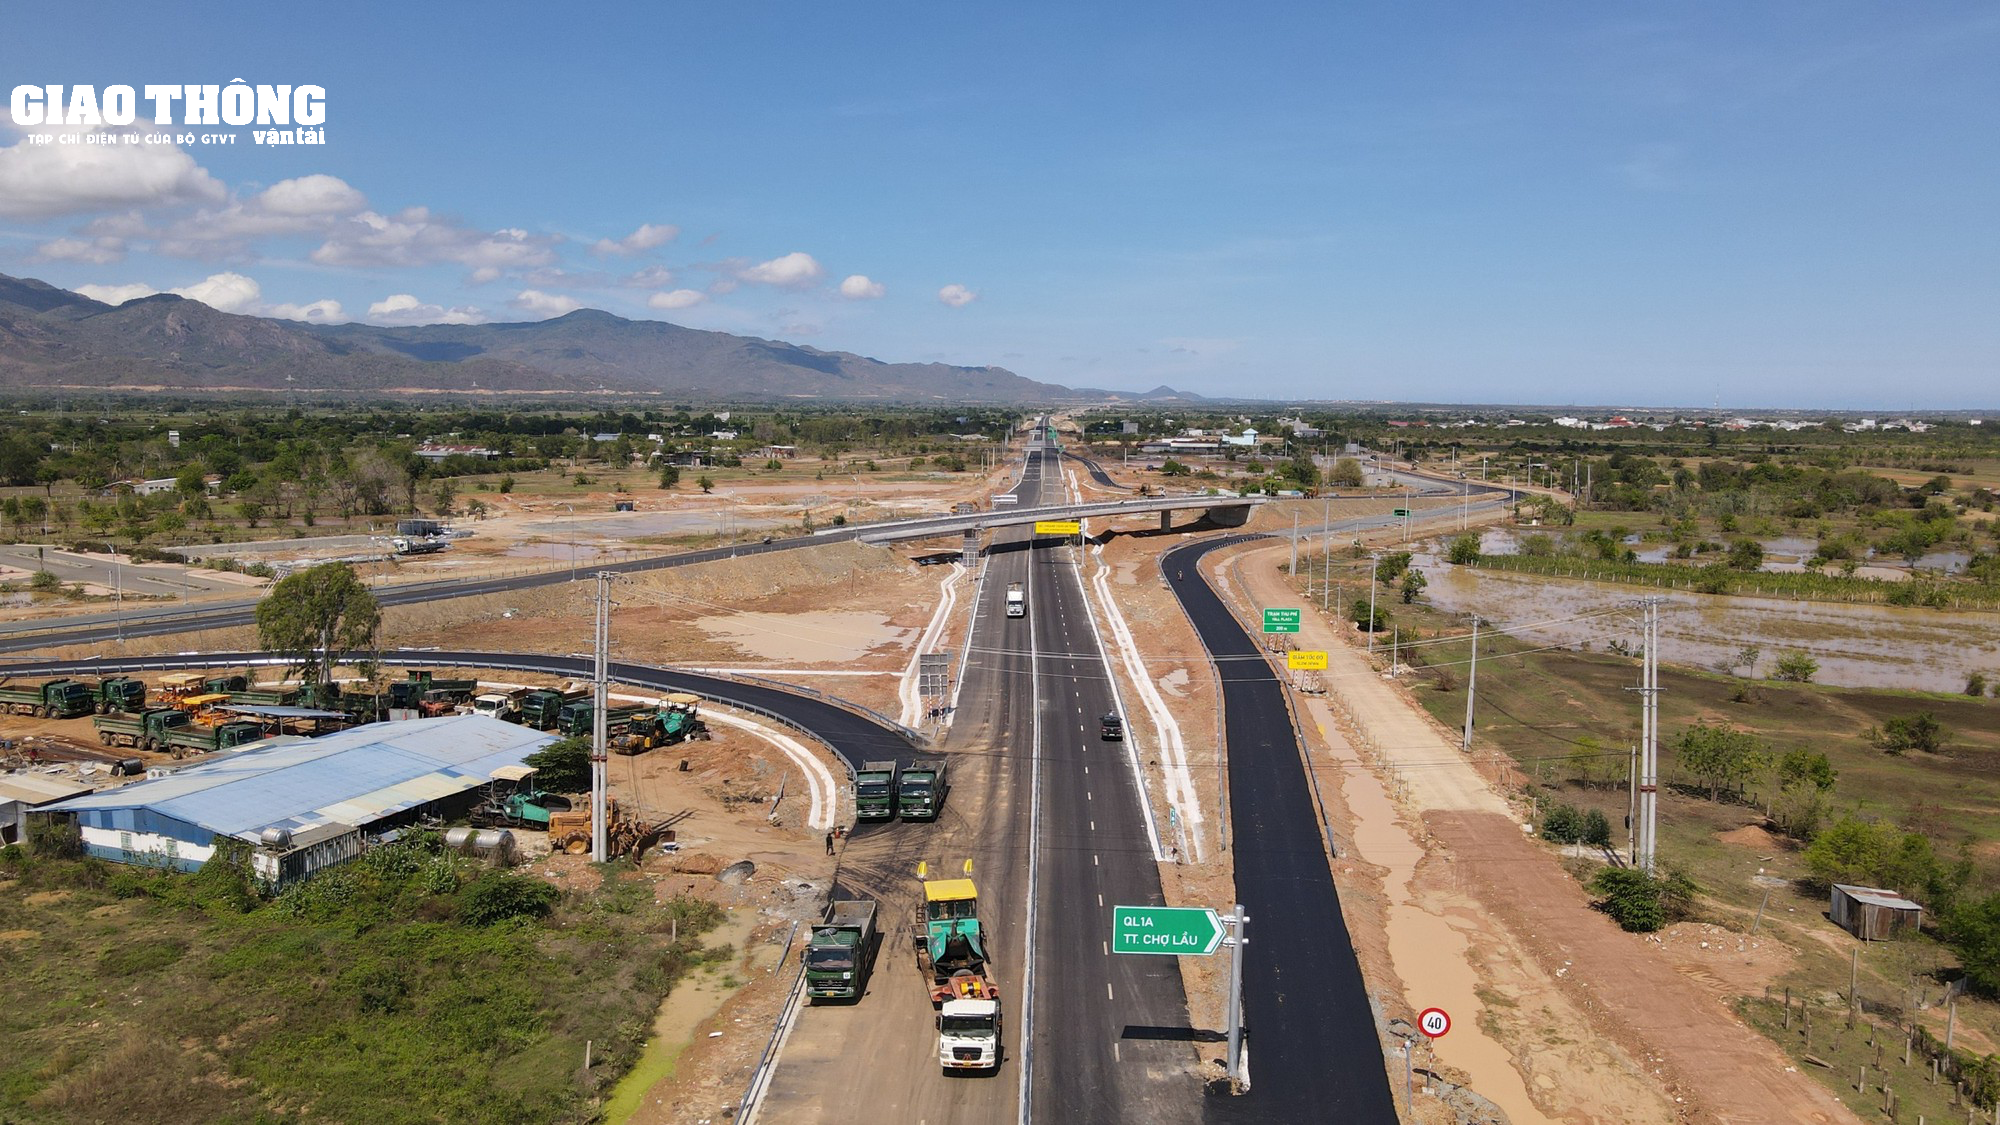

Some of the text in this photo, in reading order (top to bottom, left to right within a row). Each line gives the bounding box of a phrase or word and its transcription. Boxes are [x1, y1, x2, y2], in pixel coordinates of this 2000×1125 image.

[1123, 916, 1154, 928] QL1A
[1123, 931, 1198, 947] TT. CHỢ LẨU
[1427, 1016, 1442, 1030] 40
